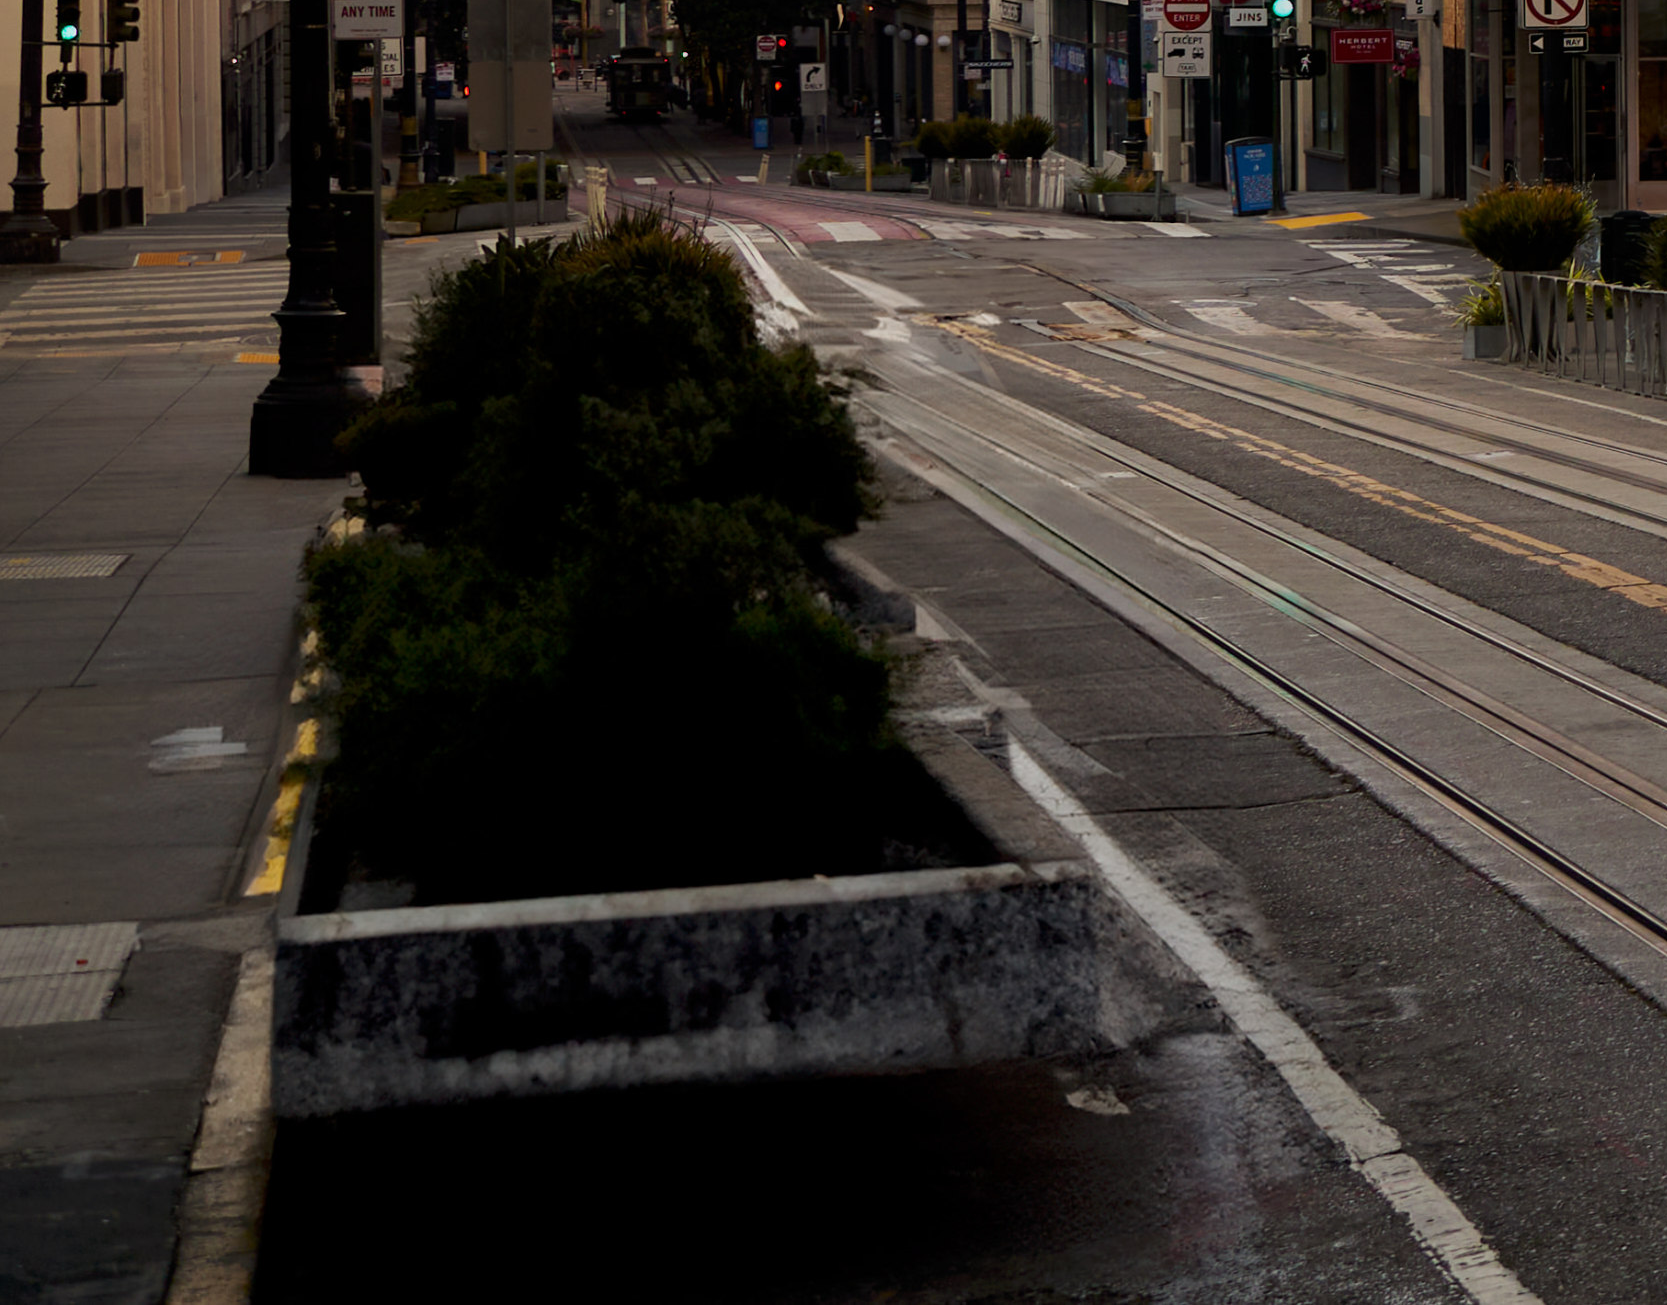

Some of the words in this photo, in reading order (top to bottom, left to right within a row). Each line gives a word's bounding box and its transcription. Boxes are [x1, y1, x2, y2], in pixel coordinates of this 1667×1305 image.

[341, 6, 365, 17] ANY
[368, 6, 396, 17] TIME
[1173, 14, 1200, 22] ENTER
[1236, 12, 1262, 22] JINS
[1171, 36, 1203, 45] EXCEPT
